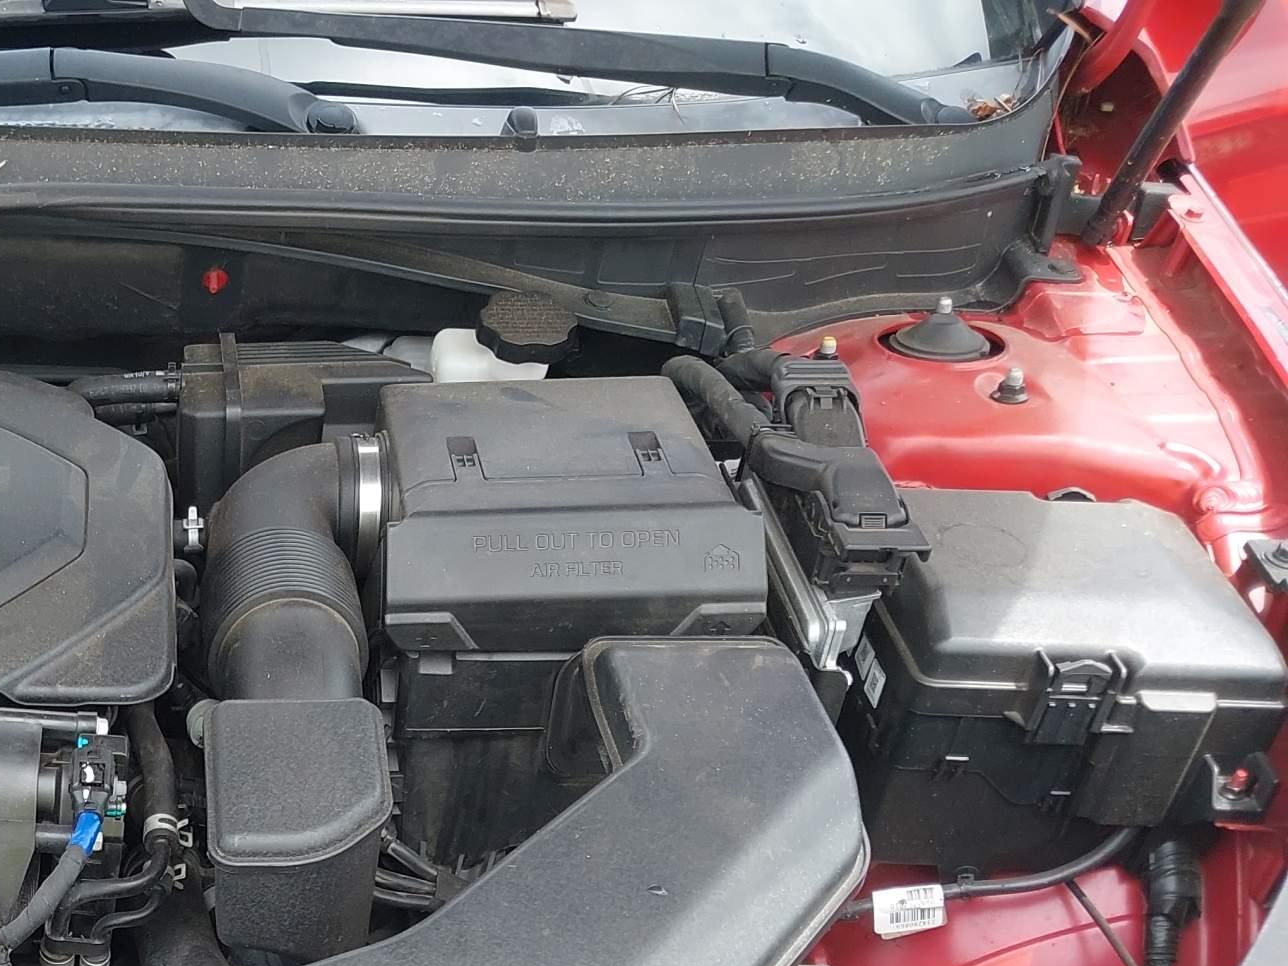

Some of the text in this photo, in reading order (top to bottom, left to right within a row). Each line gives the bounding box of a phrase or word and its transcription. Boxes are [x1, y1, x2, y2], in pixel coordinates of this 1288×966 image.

[471, 528, 681, 552] PULL OUT TO OPEN
[529, 560, 624, 578] AIR FILTER
